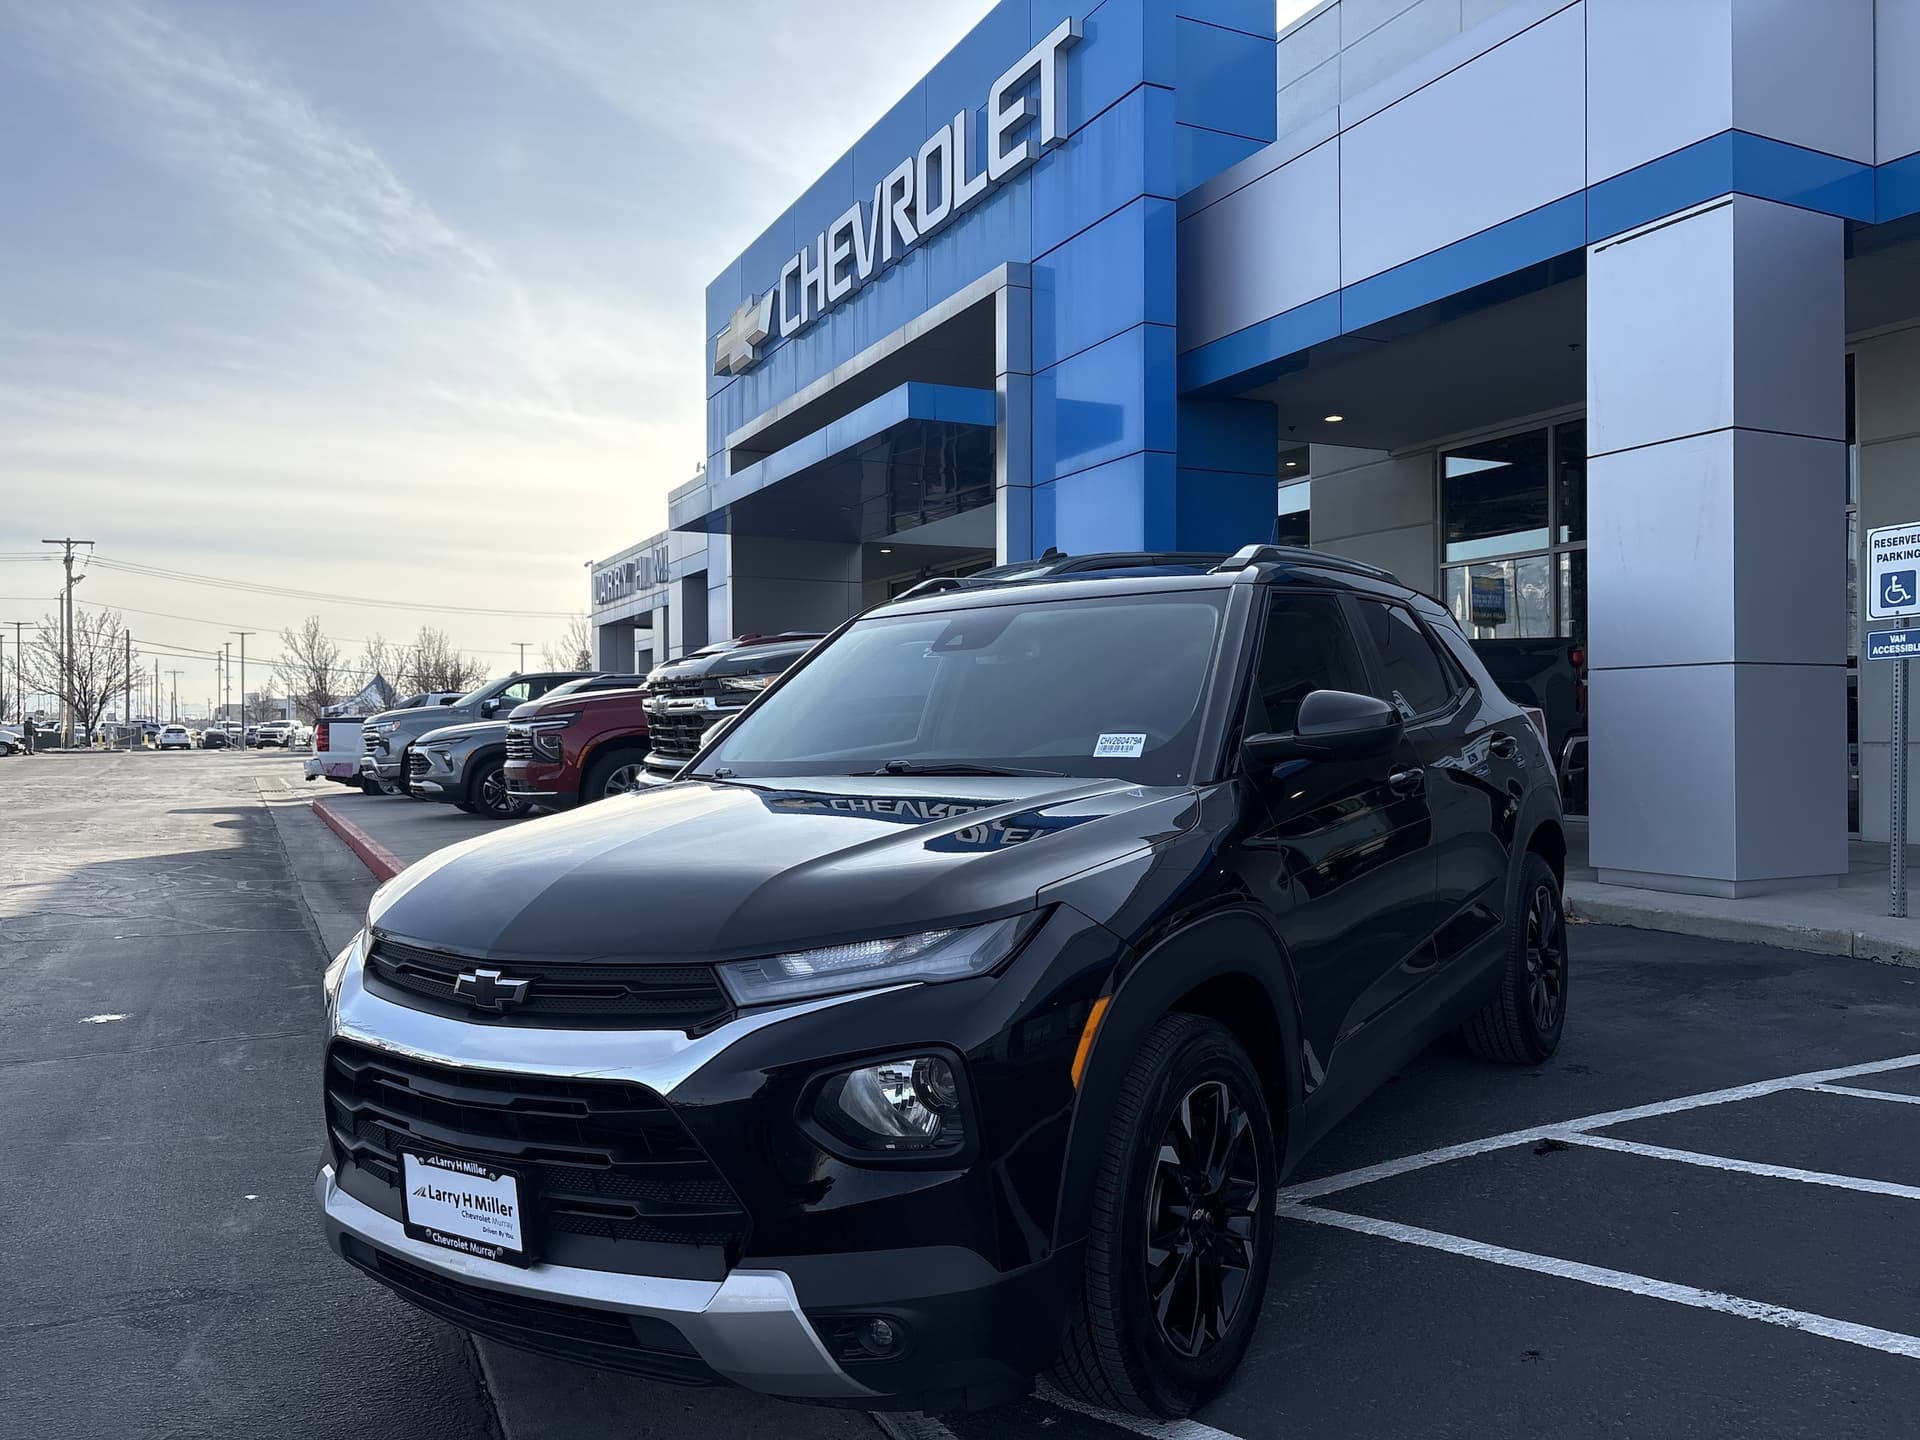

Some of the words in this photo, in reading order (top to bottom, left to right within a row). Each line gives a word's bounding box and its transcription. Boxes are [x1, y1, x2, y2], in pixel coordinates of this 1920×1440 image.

[779, 16, 1083, 338] CHEVROLET
[1877, 549, 1920, 563] PARKING
[1890, 634, 1906, 643] VAN
[1100, 736, 1142, 745] CHV260479A
[435, 1156, 455, 1171] Larry
[456, 1160, 463, 1171] H
[463, 1162, 486, 1176] Miller
[428, 1184, 460, 1208] Larry
[463, 1192, 472, 1208] H
[475, 1195, 512, 1217] Miller
[461, 1210, 491, 1224] Chevrolet
[491, 1217, 513, 1230] Murray
[482, 1226, 497, 1236] Driven
[432, 1232, 468, 1250] Chevrolet
[469, 1242, 497, 1260] Murray
